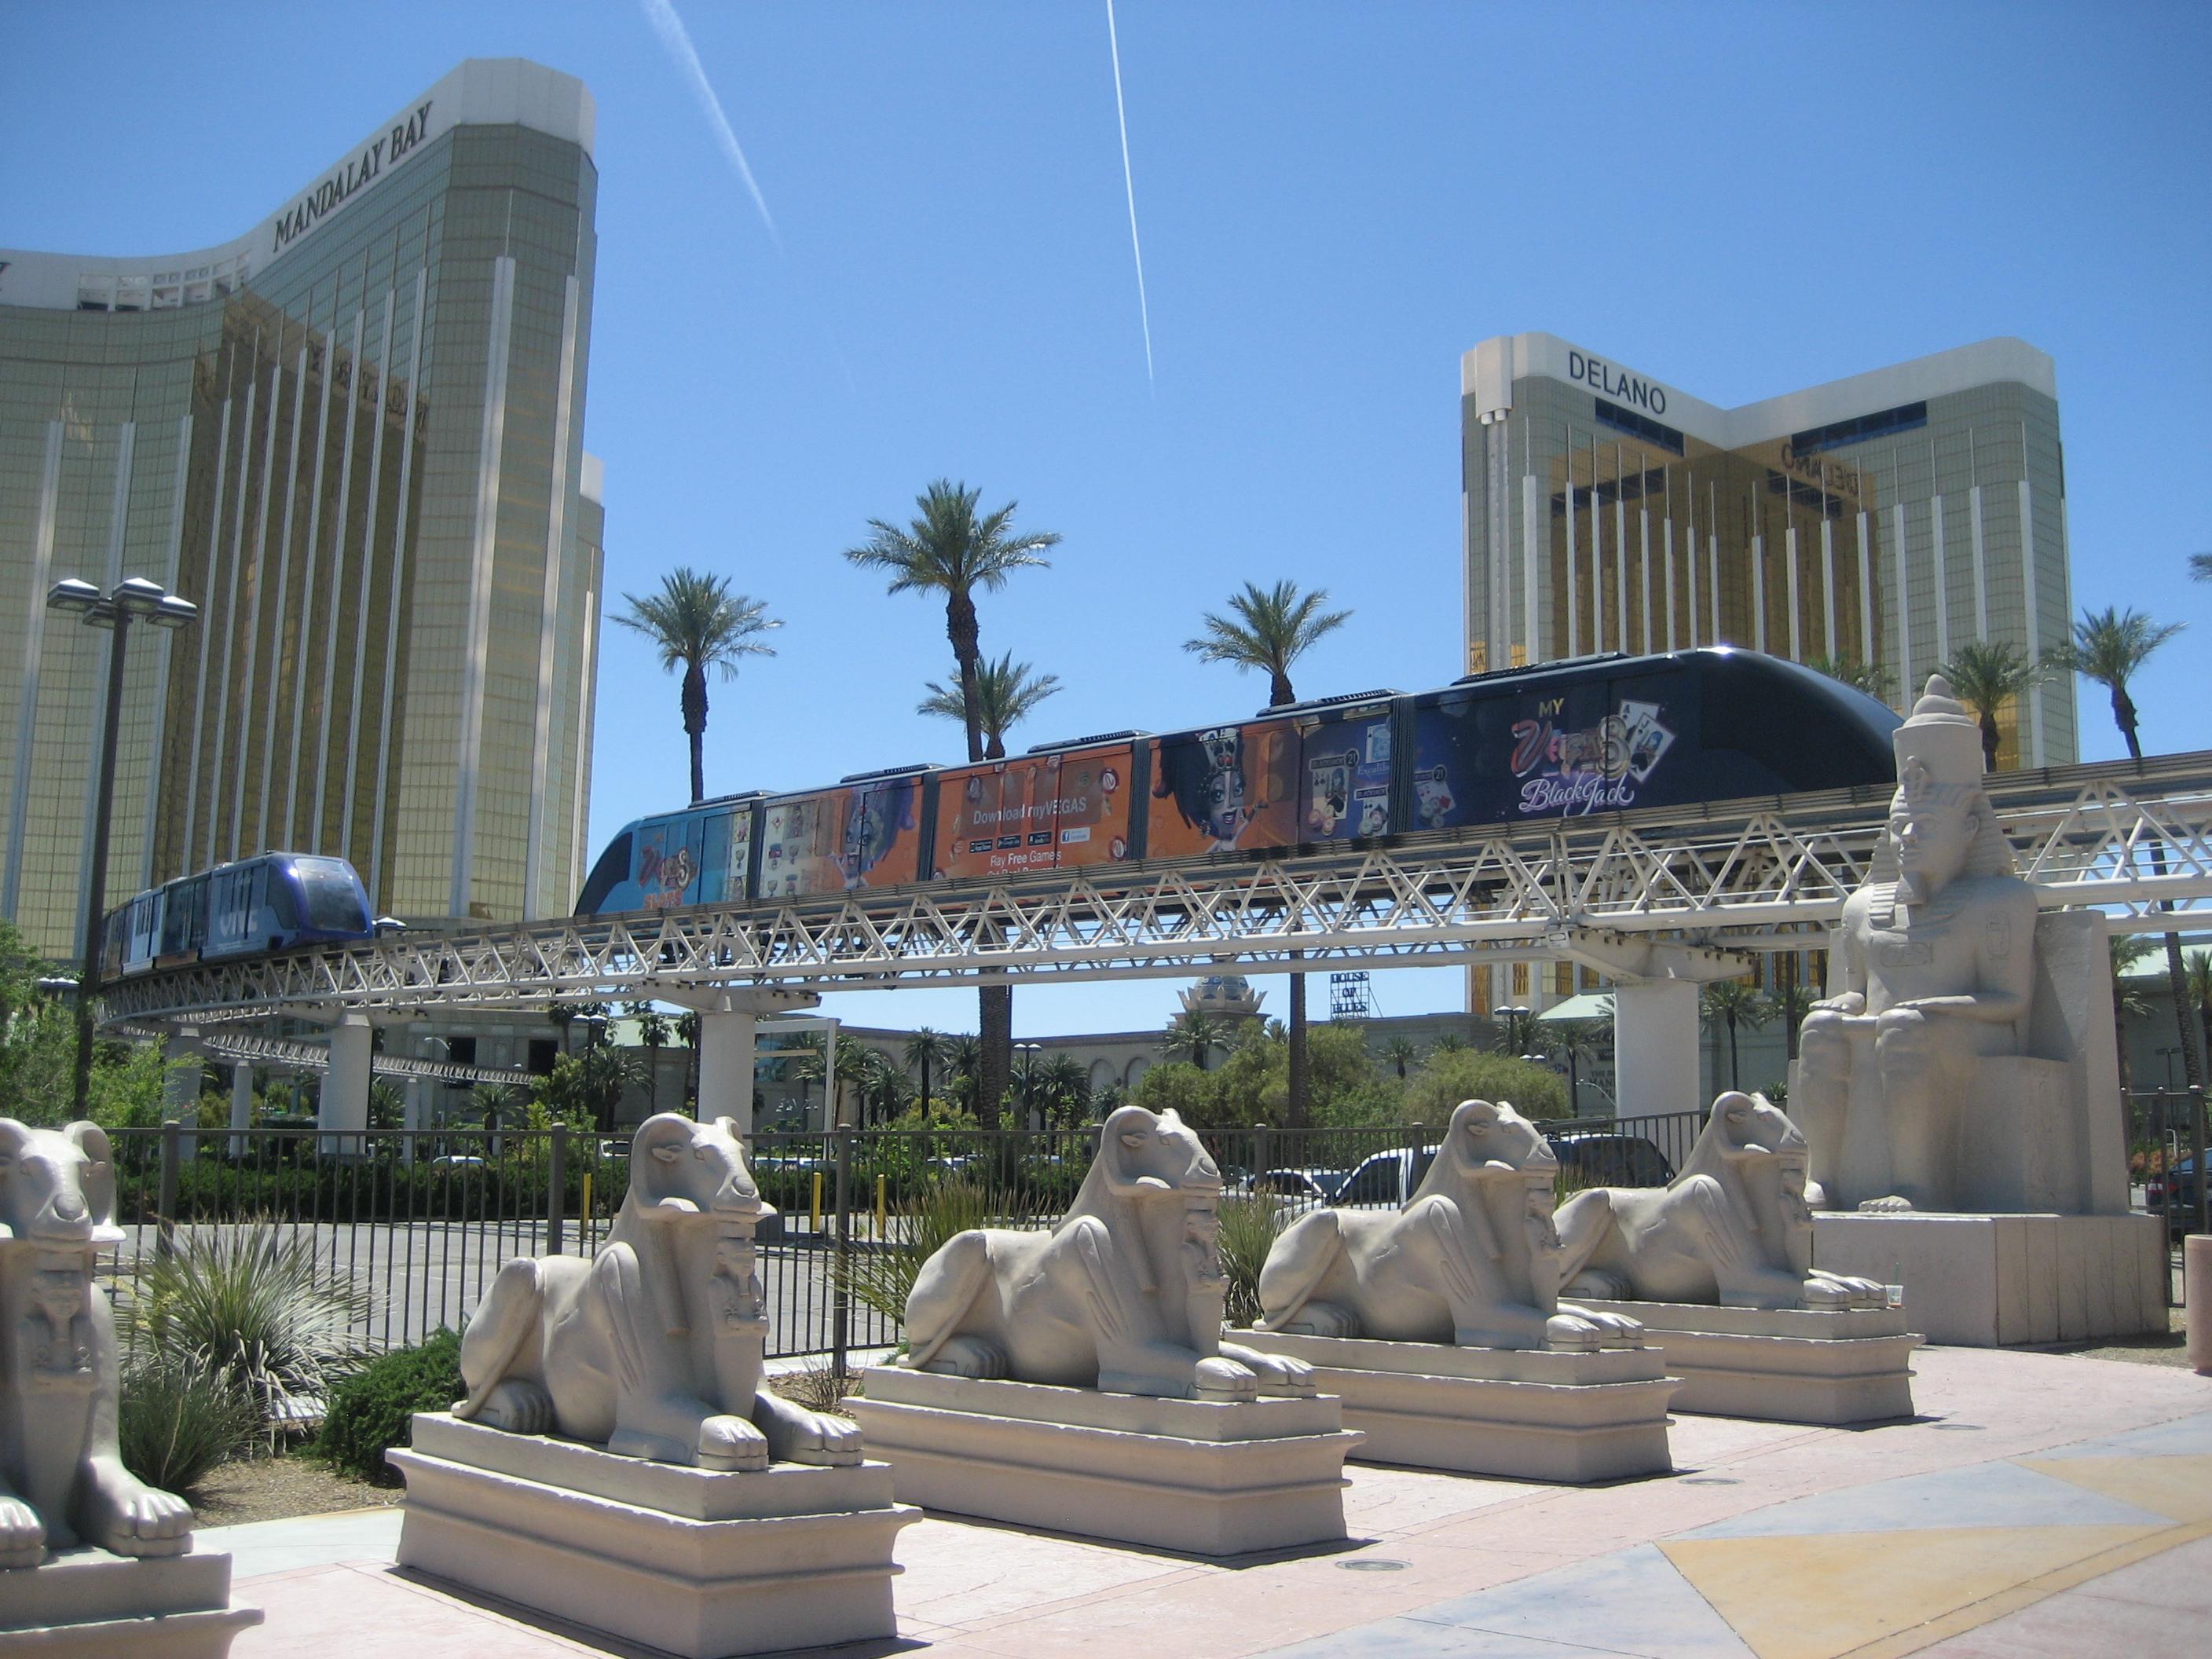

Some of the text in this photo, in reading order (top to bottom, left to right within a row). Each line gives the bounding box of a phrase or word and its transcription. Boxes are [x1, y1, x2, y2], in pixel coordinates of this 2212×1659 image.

[273, 100, 433, 253] MANDALAY BAY
[1569, 351, 1665, 415] DELANO
[1539, 698, 1565, 718] MY
[1511, 715, 1632, 782] VEGAS
[973, 797, 1087, 824] Download myVEGAS
[1008, 852, 1027, 865] Free
[1030, 850, 1061, 862] Games
[1331, 972, 1369, 983] HOUSE
[1342, 987, 1357, 998] OF
[1332, 1001, 1368, 1013] BLUES
